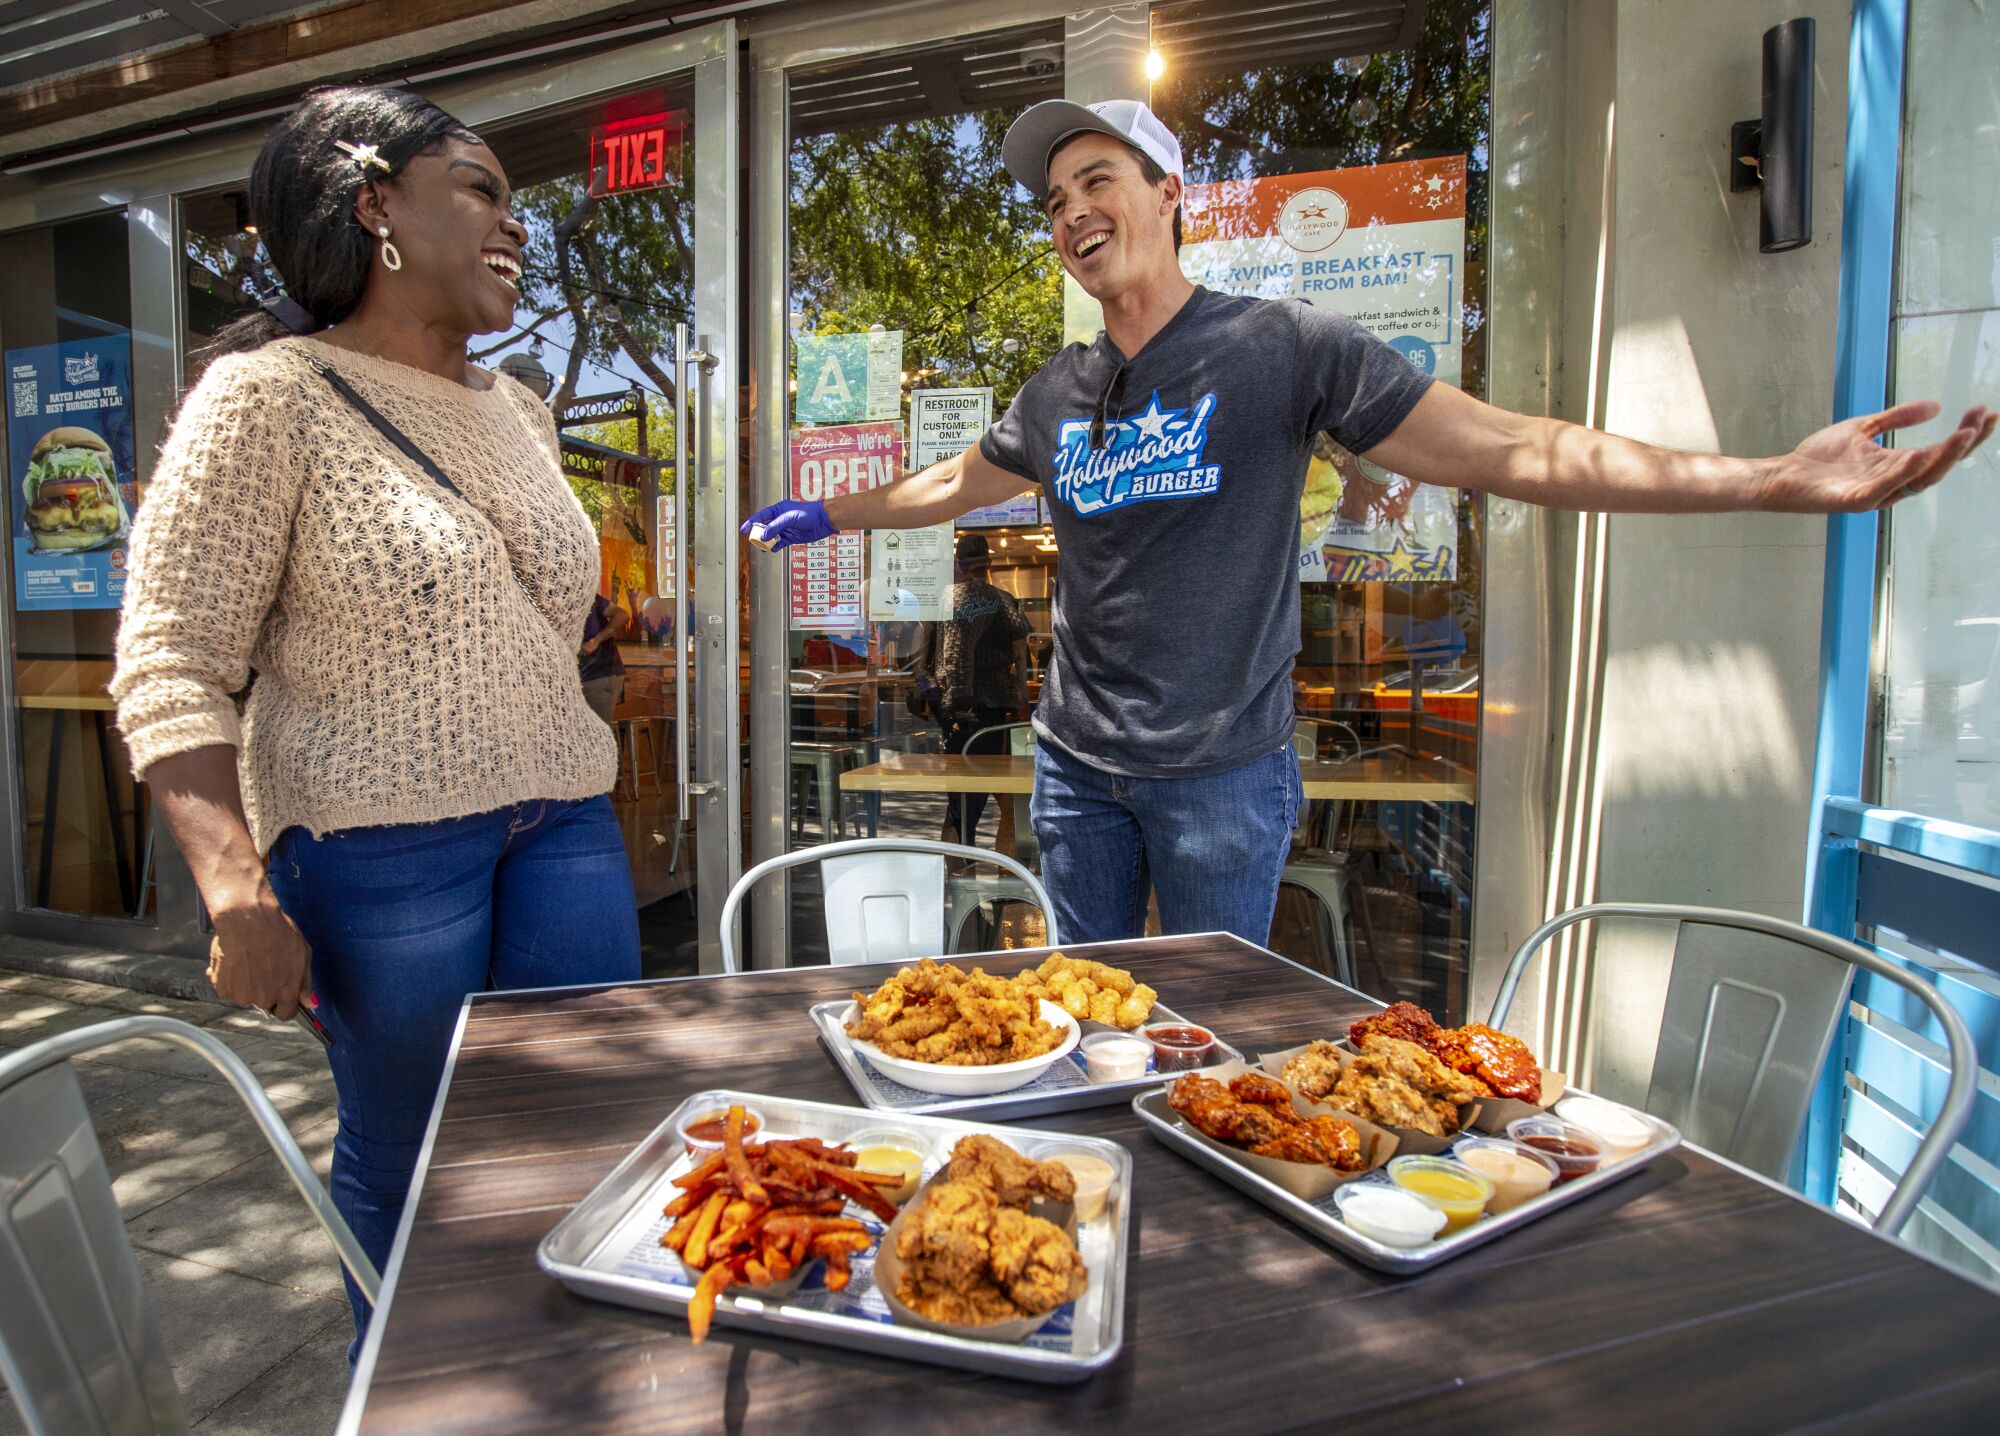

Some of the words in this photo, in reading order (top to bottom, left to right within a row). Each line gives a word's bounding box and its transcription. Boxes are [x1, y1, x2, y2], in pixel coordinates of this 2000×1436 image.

[1287, 221, 1339, 231] OLLYWOOD
[1302, 251, 1425, 276] BREAKFAST
[1303, 277, 1354, 292] FROM
[1361, 272, 1407, 288] 8AM!
[1348, 311, 1381, 321] akfast
[1384, 308, 1430, 319] sandwich
[1433, 307, 1440, 315] &
[1378, 321, 1408, 332] coffee
[1411, 321, 1422, 329] or
[1425, 320, 1440, 329] o.j.
[809, 355, 853, 404] A
[49, 392, 73, 403] RATED
[74, 388, 101, 399] AMONG
[102, 386, 118, 397] THE
[45, 404, 64, 414] BEST
[65, 399, 100, 412] BURGERS
[100, 398, 109, 408] IN
[109, 397, 123, 407] LA!
[925, 399, 979, 410] RESTROOM
[942, 412, 960, 421] FOR
[923, 421, 979, 431] CUSTOMERS
[799, 436, 834, 455] Come
[839, 434, 853, 446] in
[857, 432, 892, 451] We're
[939, 431, 961, 440] ONLY
[1055, 398, 1212, 501] Hollywood
[800, 454, 893, 502] OPEN
[1131, 466, 1220, 495] BURGER
[107, 581, 126, 592] Goo
